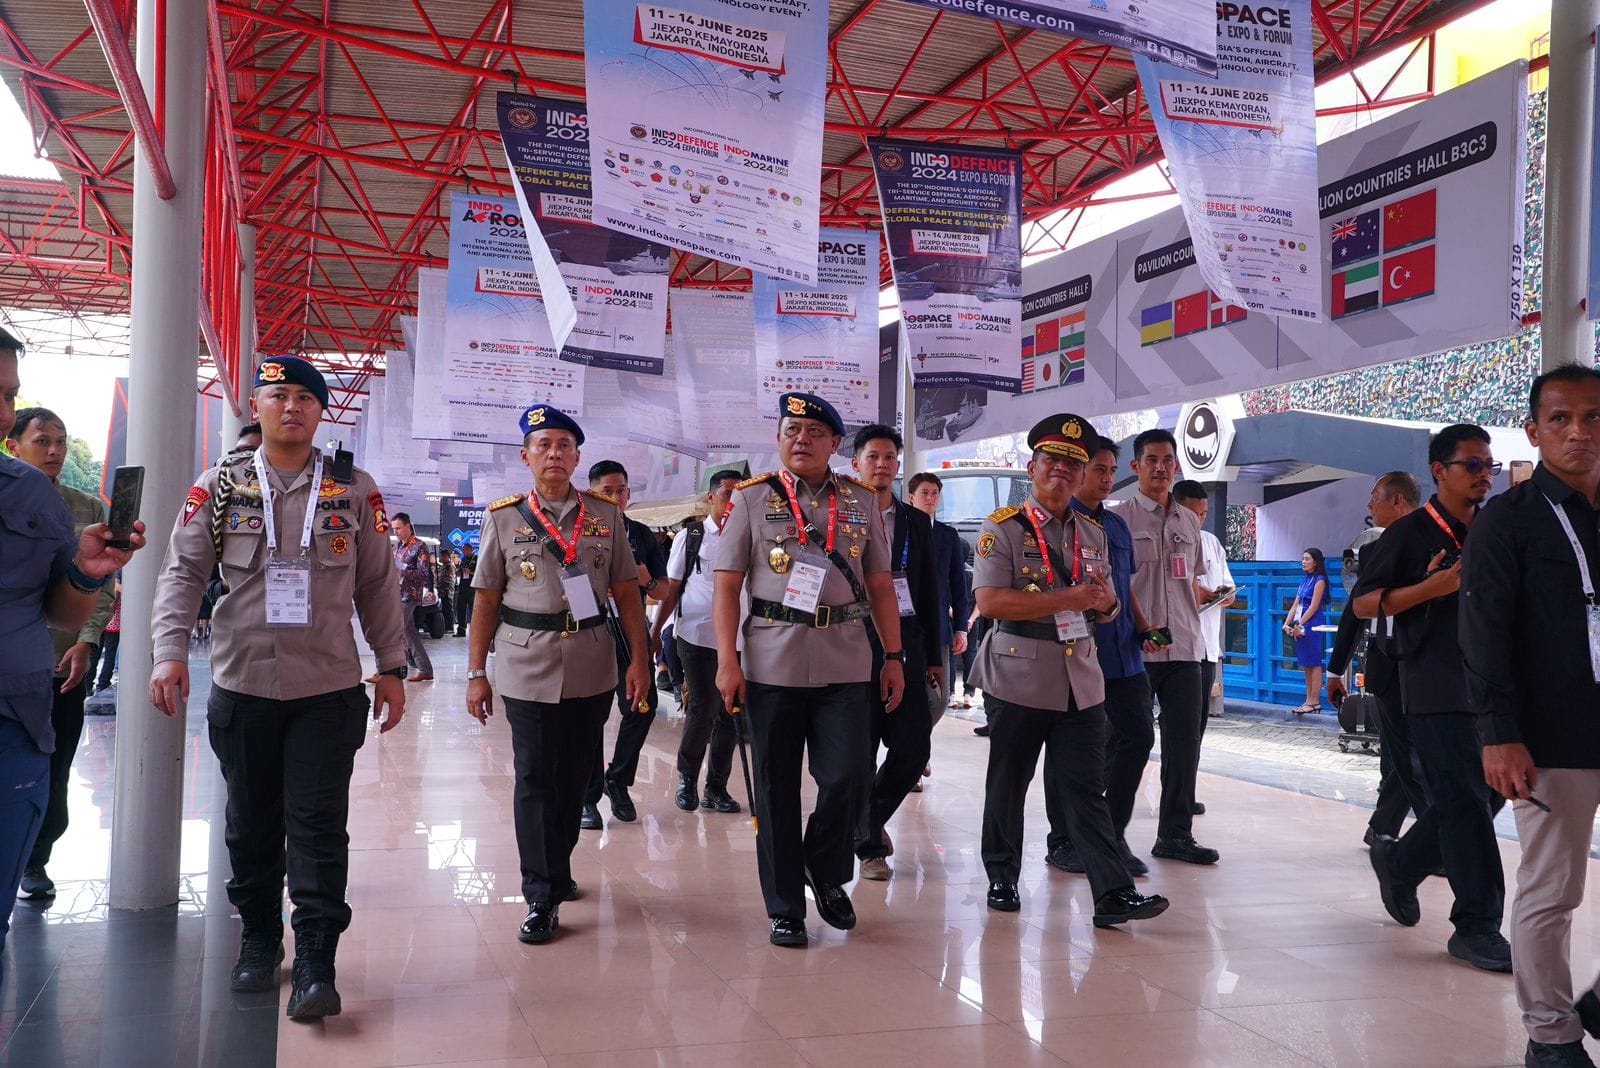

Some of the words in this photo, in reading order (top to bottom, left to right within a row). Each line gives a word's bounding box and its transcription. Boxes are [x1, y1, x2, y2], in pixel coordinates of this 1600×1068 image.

[769, 6, 802, 18] EVENT
[930, 0, 1074, 32] odefence.com
[649, 8, 664, 19] 11
[679, 13, 694, 25] 14
[697, 18, 733, 34] JUNE
[735, 28, 768, 41] 2025
[651, 22, 692, 36] JIEXPO
[694, 31, 768, 55] KEMAYORAN,
[1098, 29, 1133, 44] Connect
[1228, 25, 1250, 40] EXPO
[1254, 28, 1260, 41] &
[1264, 29, 1292, 45] FORUM
[649, 31, 705, 50] JAKARTA,
[708, 43, 769, 64] INDONESIA
[1243, 47, 1283, 58] OFFICIAL
[1170, 83, 1183, 93] 11
[1194, 85, 1208, 96] 14
[1210, 87, 1240, 99] JUNE
[1242, 91, 1269, 102] 2025
[1173, 97, 1206, 107] JIEXPO
[1208, 100, 1270, 115] KEMAYORAN,
[1173, 105, 1219, 118] JAKARTA,
[1220, 110, 1271, 123] INDONESIA
[546, 126, 590, 142] 202
[517, 147, 566, 157] TRI-SERVICE
[651, 137, 681, 150] 2024
[682, 144, 695, 154] EXPO
[701, 148, 719, 159] FORUM
[743, 159, 773, 173] 2024
[513, 165, 560, 177] DEFENCE
[566, 159, 584, 167] AND
[1345, 164, 1412, 200] COUNTRIES
[1416, 149, 1448, 176] HALL
[1450, 134, 1488, 162] B3C3
[912, 167, 958, 181] 2024
[960, 170, 980, 182] EXPO
[982, 173, 988, 184] &
[989, 173, 1015, 186] FORUM
[555, 180, 589, 190] PEACE
[924, 184, 966, 192] INDONESIA'S
[468, 201, 503, 212] INDO
[885, 207, 927, 215] DEFENCE
[929, 208, 994, 220] PARTNERSHIPS
[996, 215, 1013, 223] FOR
[923, 217, 952, 225] PEACE
[1258, 215, 1281, 225] 2024
[489, 227, 527, 239] 2024
[606, 216, 741, 262] www.indoaerospace.com
[824, 255, 838, 264] EXPO
[847, 257, 866, 265] FORUM
[1137, 255, 1172, 275] PAVILION
[1512, 244, 1522, 272] 130
[1512, 277, 1521, 289] X
[605, 297, 636, 308] 2024
[1035, 289, 1067, 309] COUNTRIES
[1068, 284, 1083, 298] HALL
[1084, 282, 1089, 293] F
[1511, 292, 1521, 321] 750
[976, 323, 1000, 332] 2024
